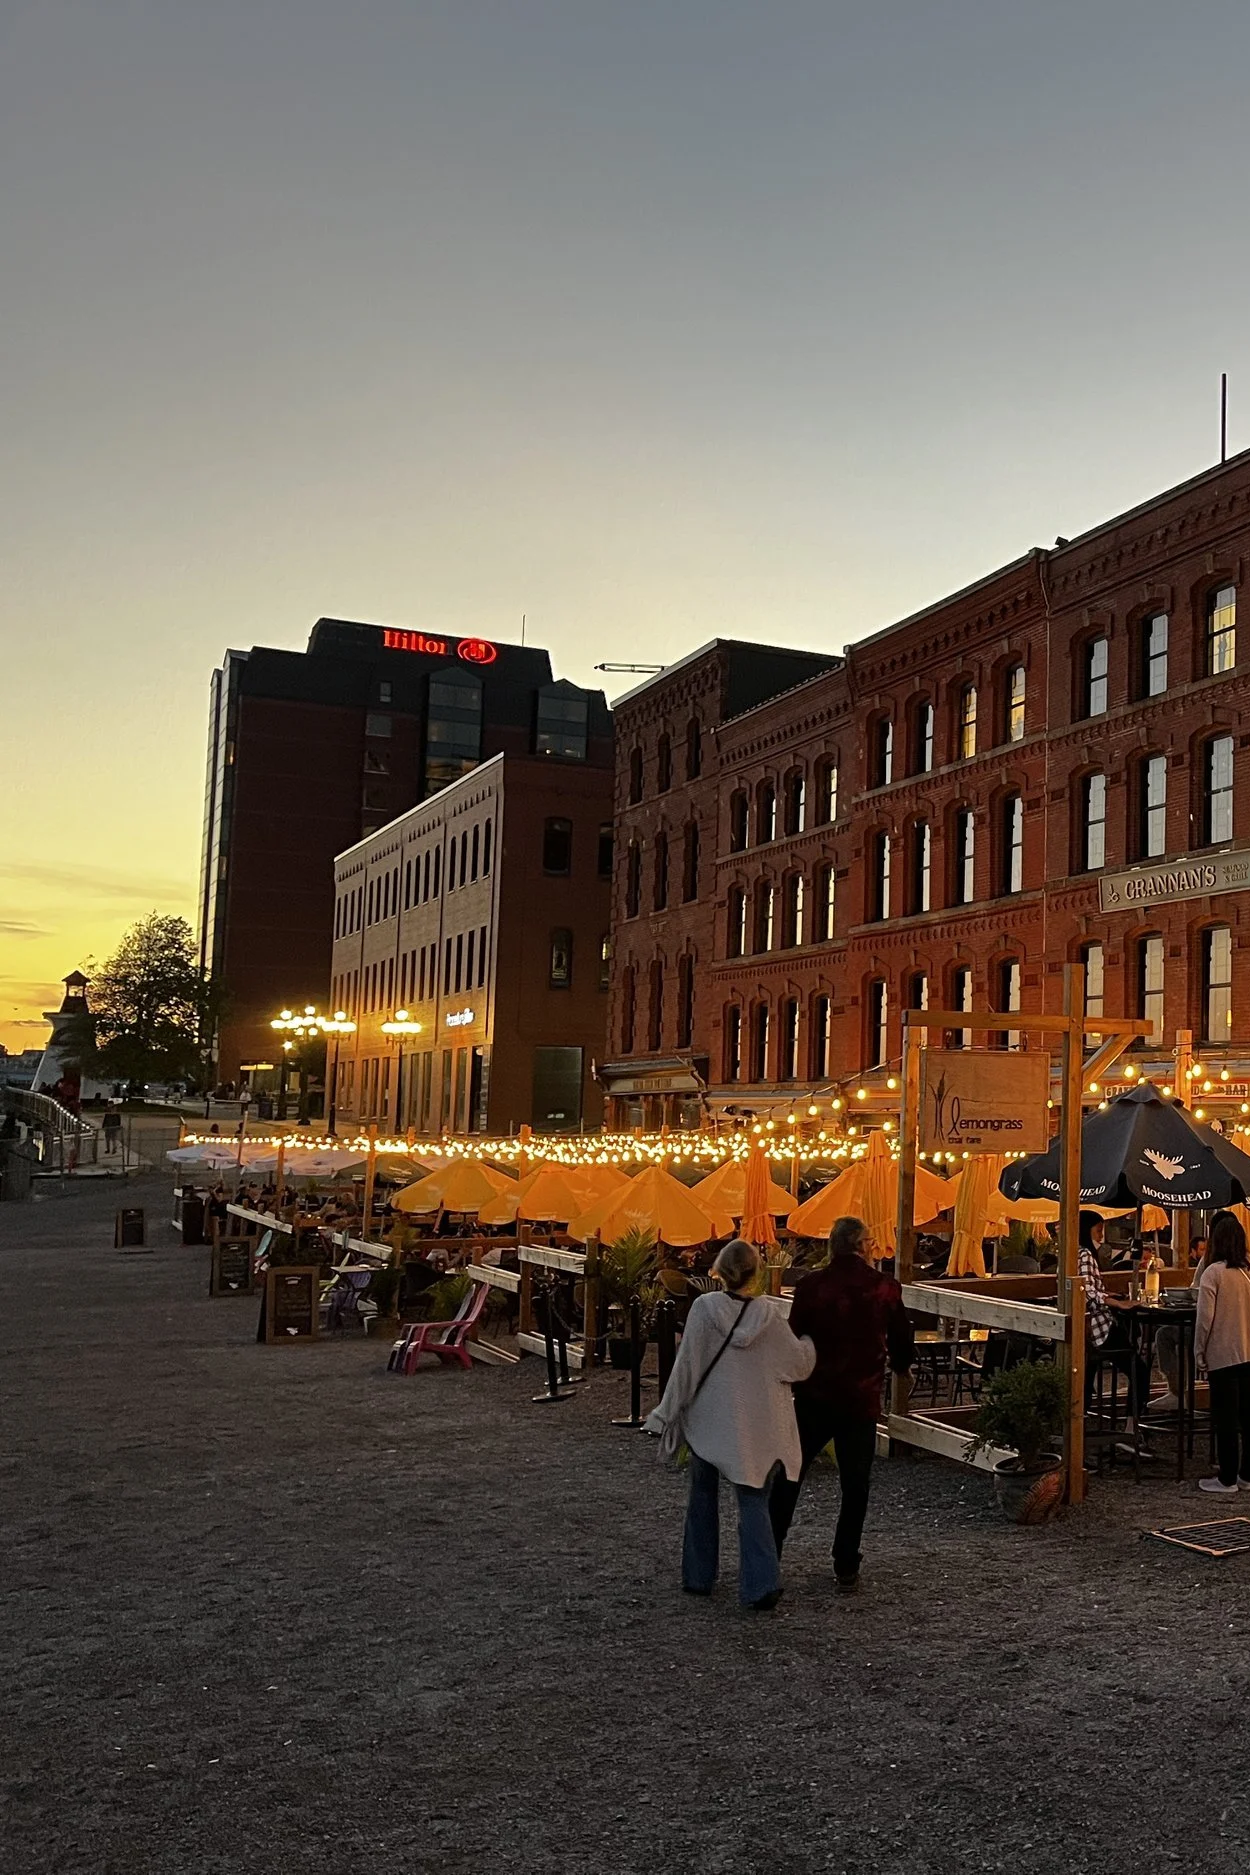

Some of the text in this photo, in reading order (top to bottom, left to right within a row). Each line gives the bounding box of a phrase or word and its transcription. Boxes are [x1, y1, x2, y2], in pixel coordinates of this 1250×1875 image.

[1124, 865, 1216, 900] GRANNAN'S
[948, 1096, 1023, 1136] lemongrass
[1142, 1184, 1212, 1203] MOOSEHEAD
